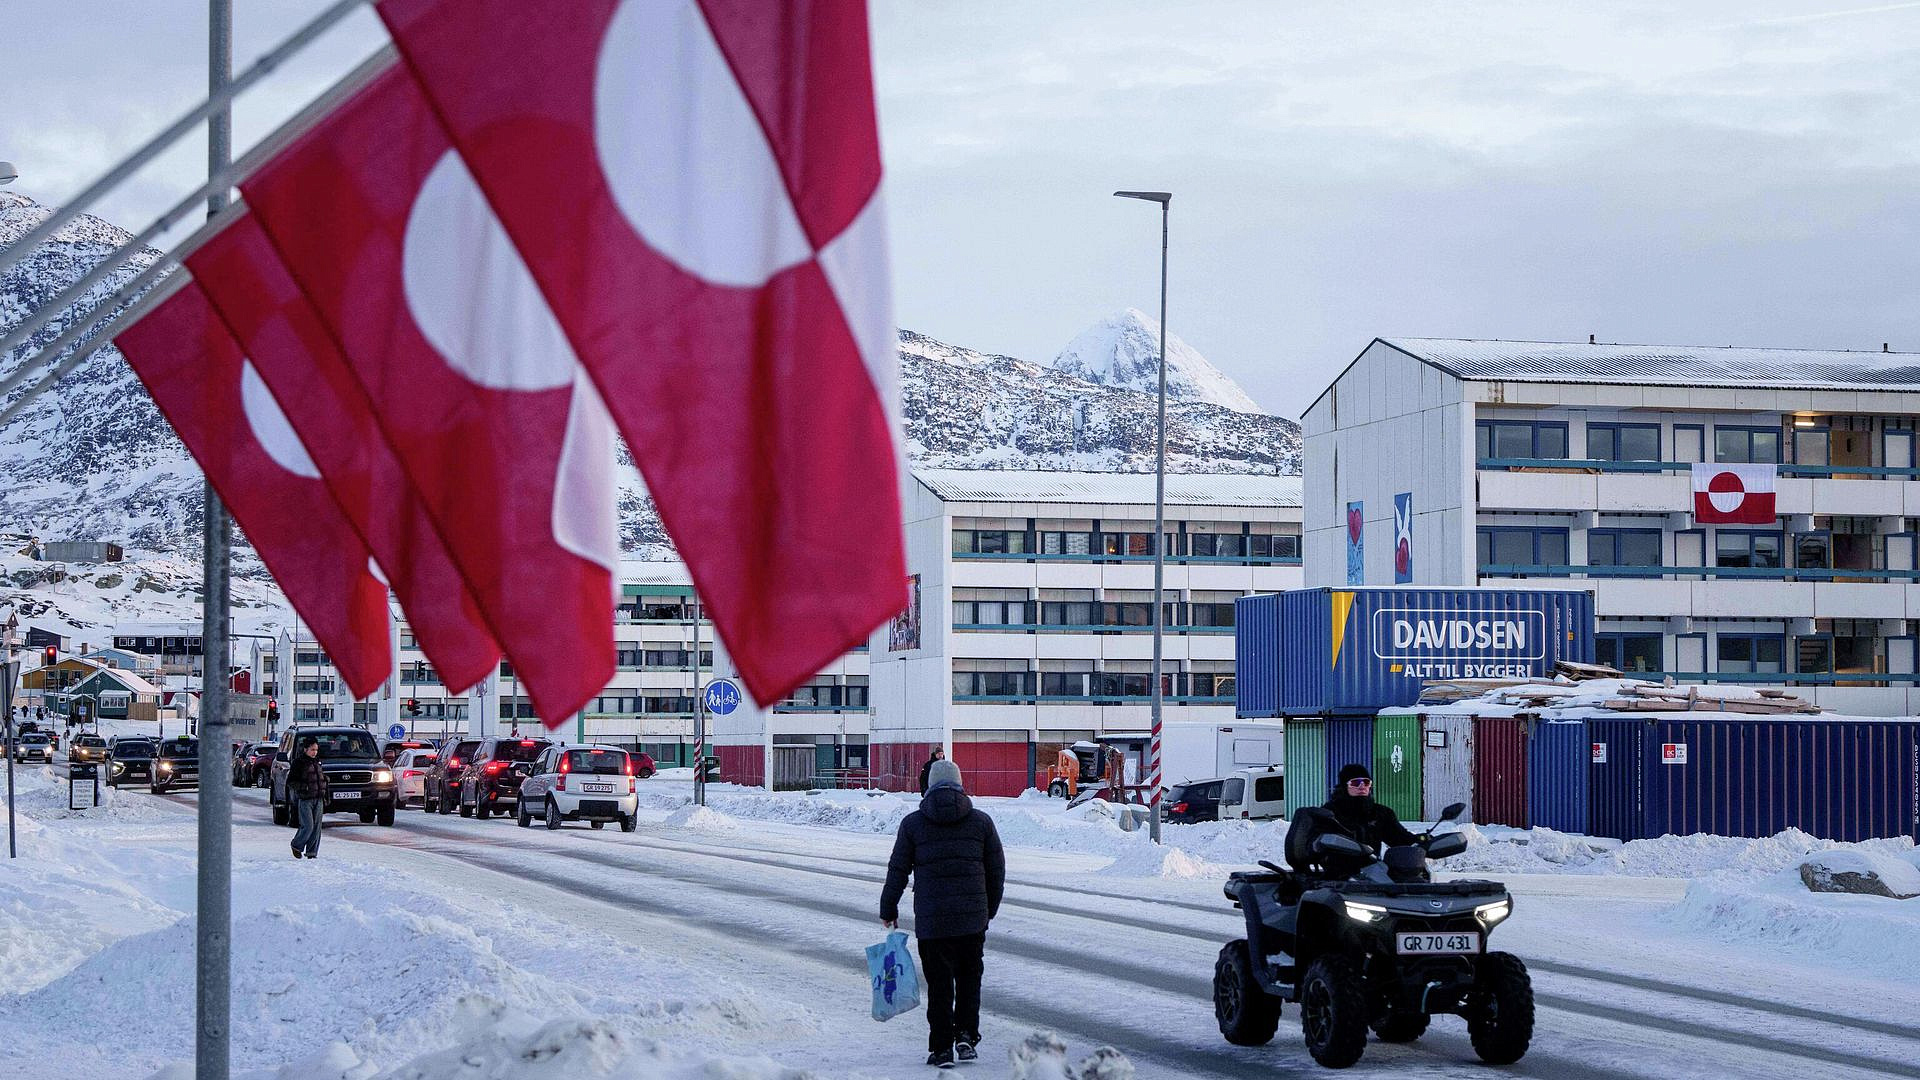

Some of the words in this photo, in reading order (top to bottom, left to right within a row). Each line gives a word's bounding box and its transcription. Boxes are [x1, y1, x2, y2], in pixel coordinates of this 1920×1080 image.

[1394, 620, 1526, 650] DAVIDSEN
[1404, 664, 1434, 678] ALT
[1435, 664, 1460, 678] TIL
[1464, 664, 1531, 679] BYGGERI
[1404, 936, 1422, 951] GR
[1426, 936, 1443, 950] 70
[1447, 936, 1471, 950] 431
